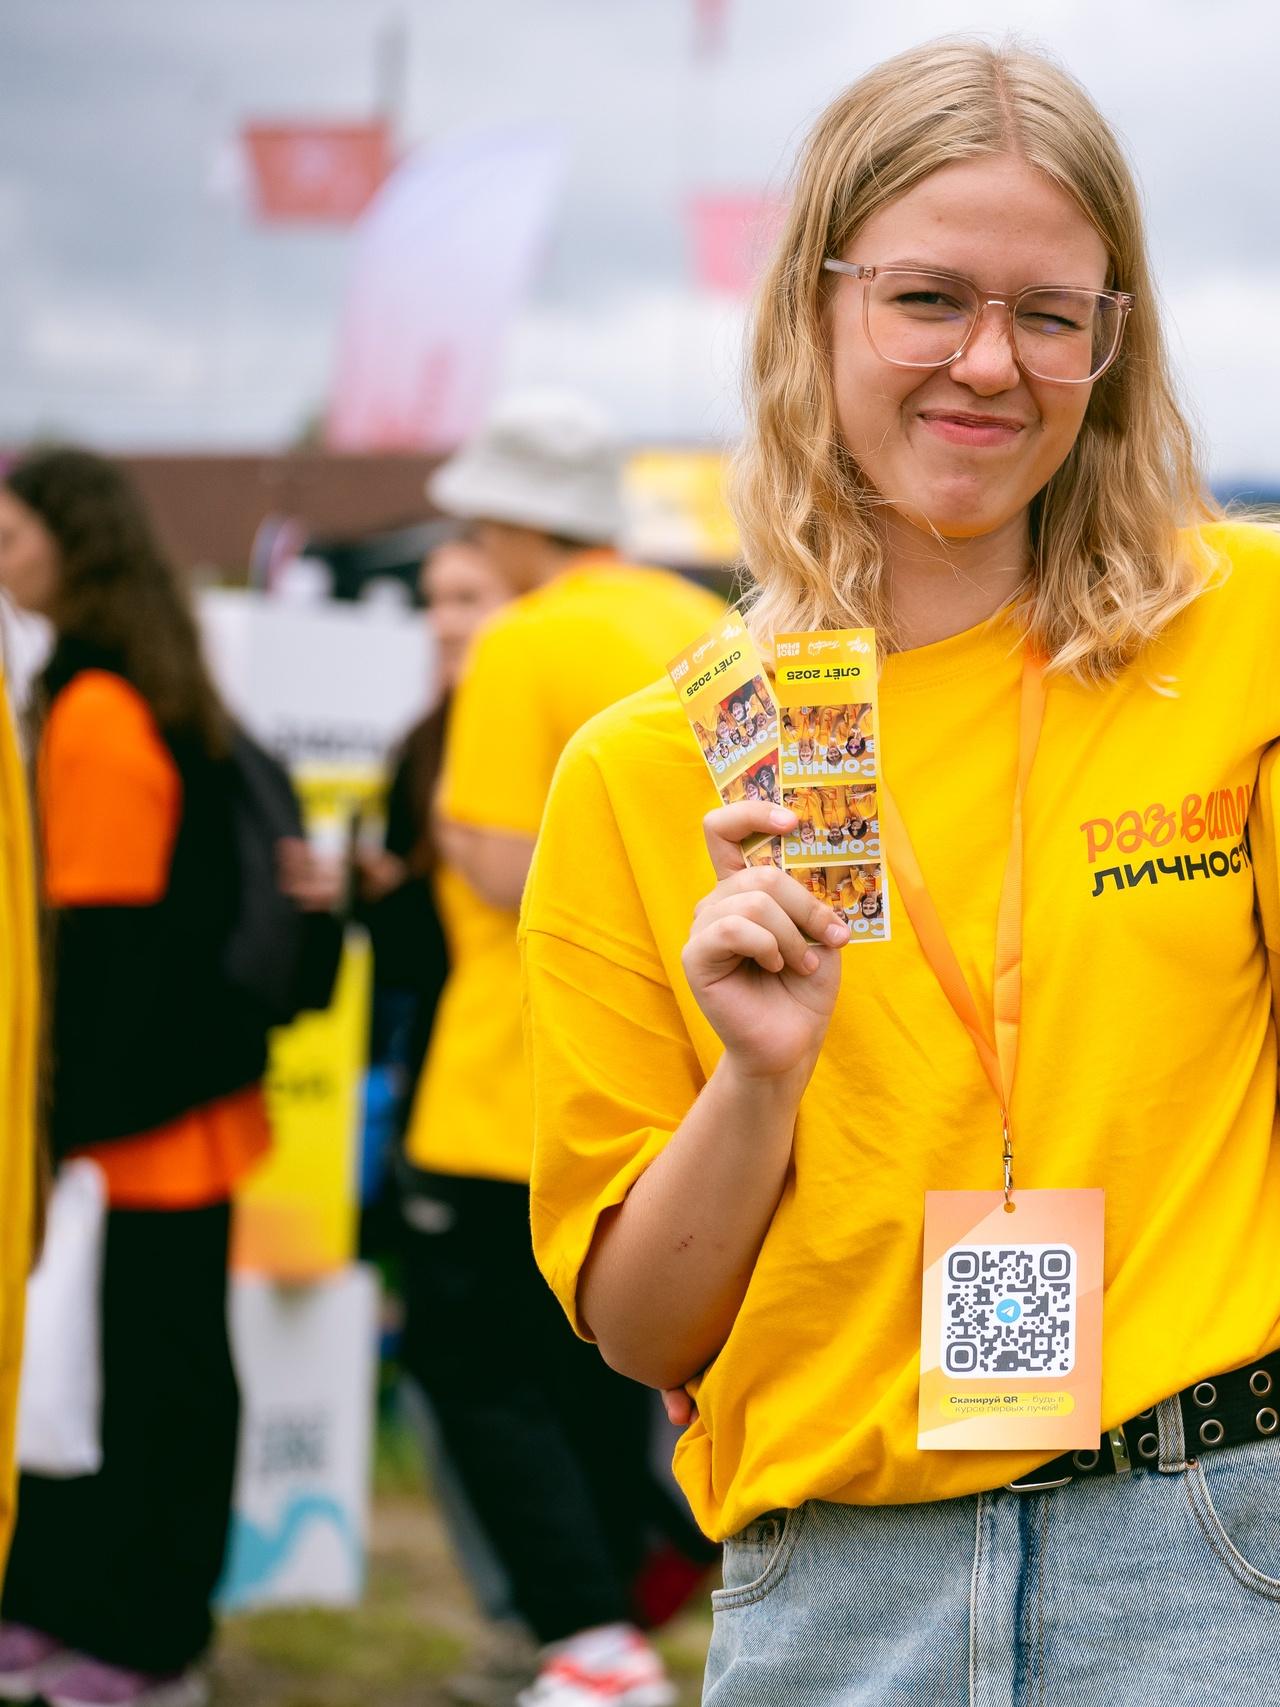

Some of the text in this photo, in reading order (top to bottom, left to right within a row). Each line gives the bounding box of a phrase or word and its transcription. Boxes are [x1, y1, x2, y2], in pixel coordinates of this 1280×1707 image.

[713, 650, 741, 676] СЛЁТ
[686, 671, 712, 697] 2025
[786, 667, 861, 681] СЛЁТ 2025
[949, 1396, 1001, 1405] Сканируй
